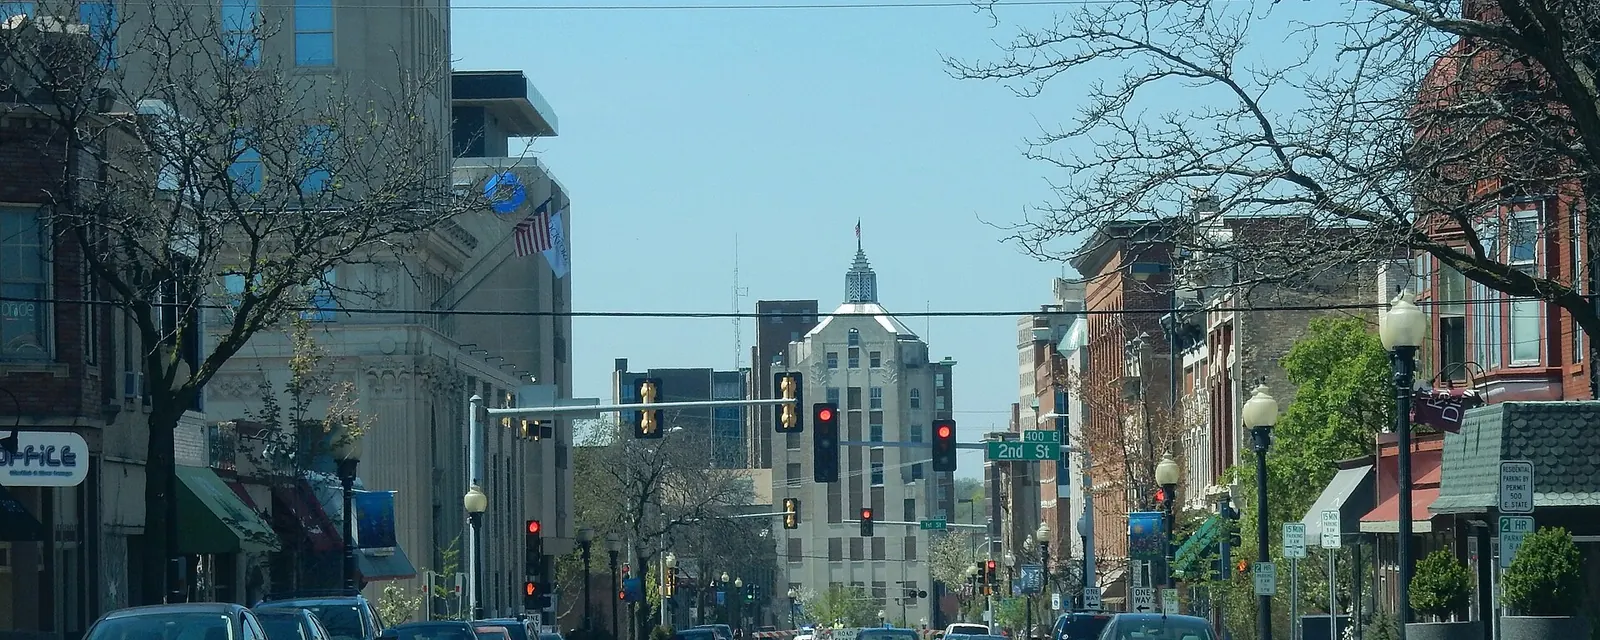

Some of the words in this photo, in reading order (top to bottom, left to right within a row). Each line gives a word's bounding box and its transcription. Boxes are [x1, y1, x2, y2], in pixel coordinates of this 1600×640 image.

[1025, 431, 1044, 441] 400
[1052, 431, 1058, 441] E
[998, 443, 1023, 459] 2nd
[1035, 444, 1050, 459] St
[1501, 519, 1509, 532] 2
[1515, 521, 1527, 530] HR
